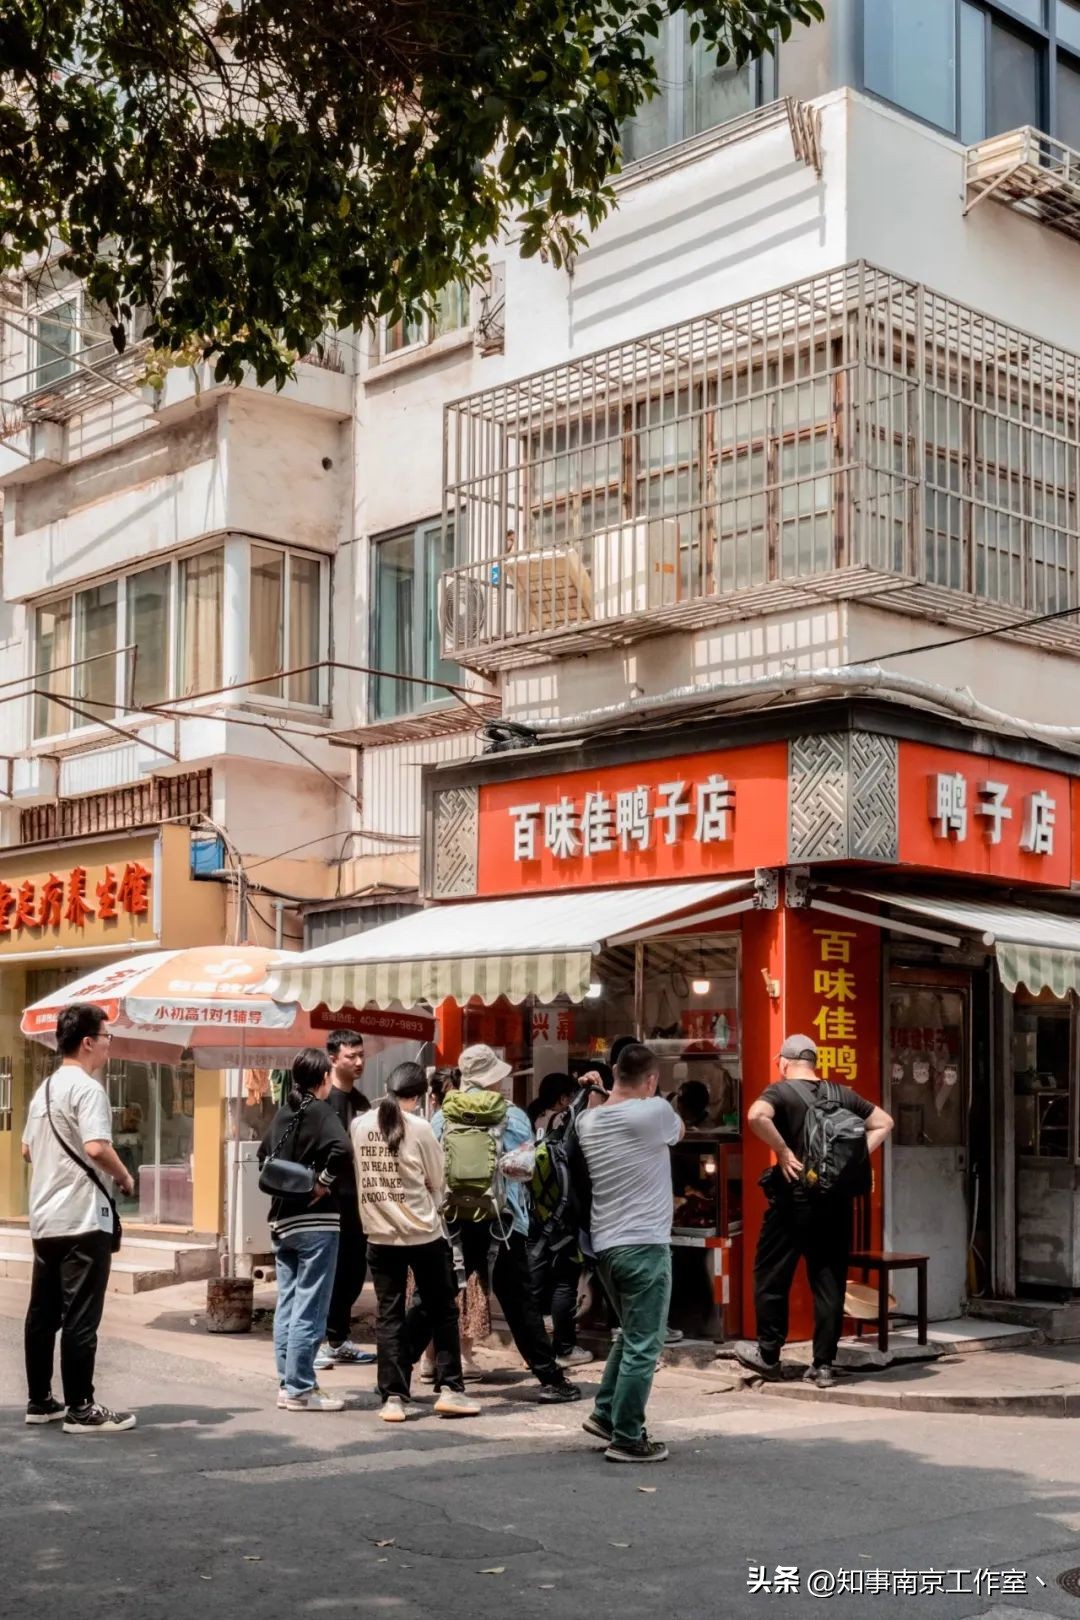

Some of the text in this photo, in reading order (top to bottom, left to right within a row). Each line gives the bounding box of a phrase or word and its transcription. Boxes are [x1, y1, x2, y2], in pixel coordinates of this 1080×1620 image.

[508, 774, 729, 861] 百味佳鸭子店
[928, 771, 1057, 856] 鸭子店
[154, 1006, 264, 1025] 小初高1对1辅导
[812, 928, 858, 1088] 百味佳鸭
[360, 1146, 378, 1157] THE
[371, 1161, 400, 1173] HEART
[361, 1177, 378, 1188] CAN
[367, 1191, 387, 1203] GOOD
